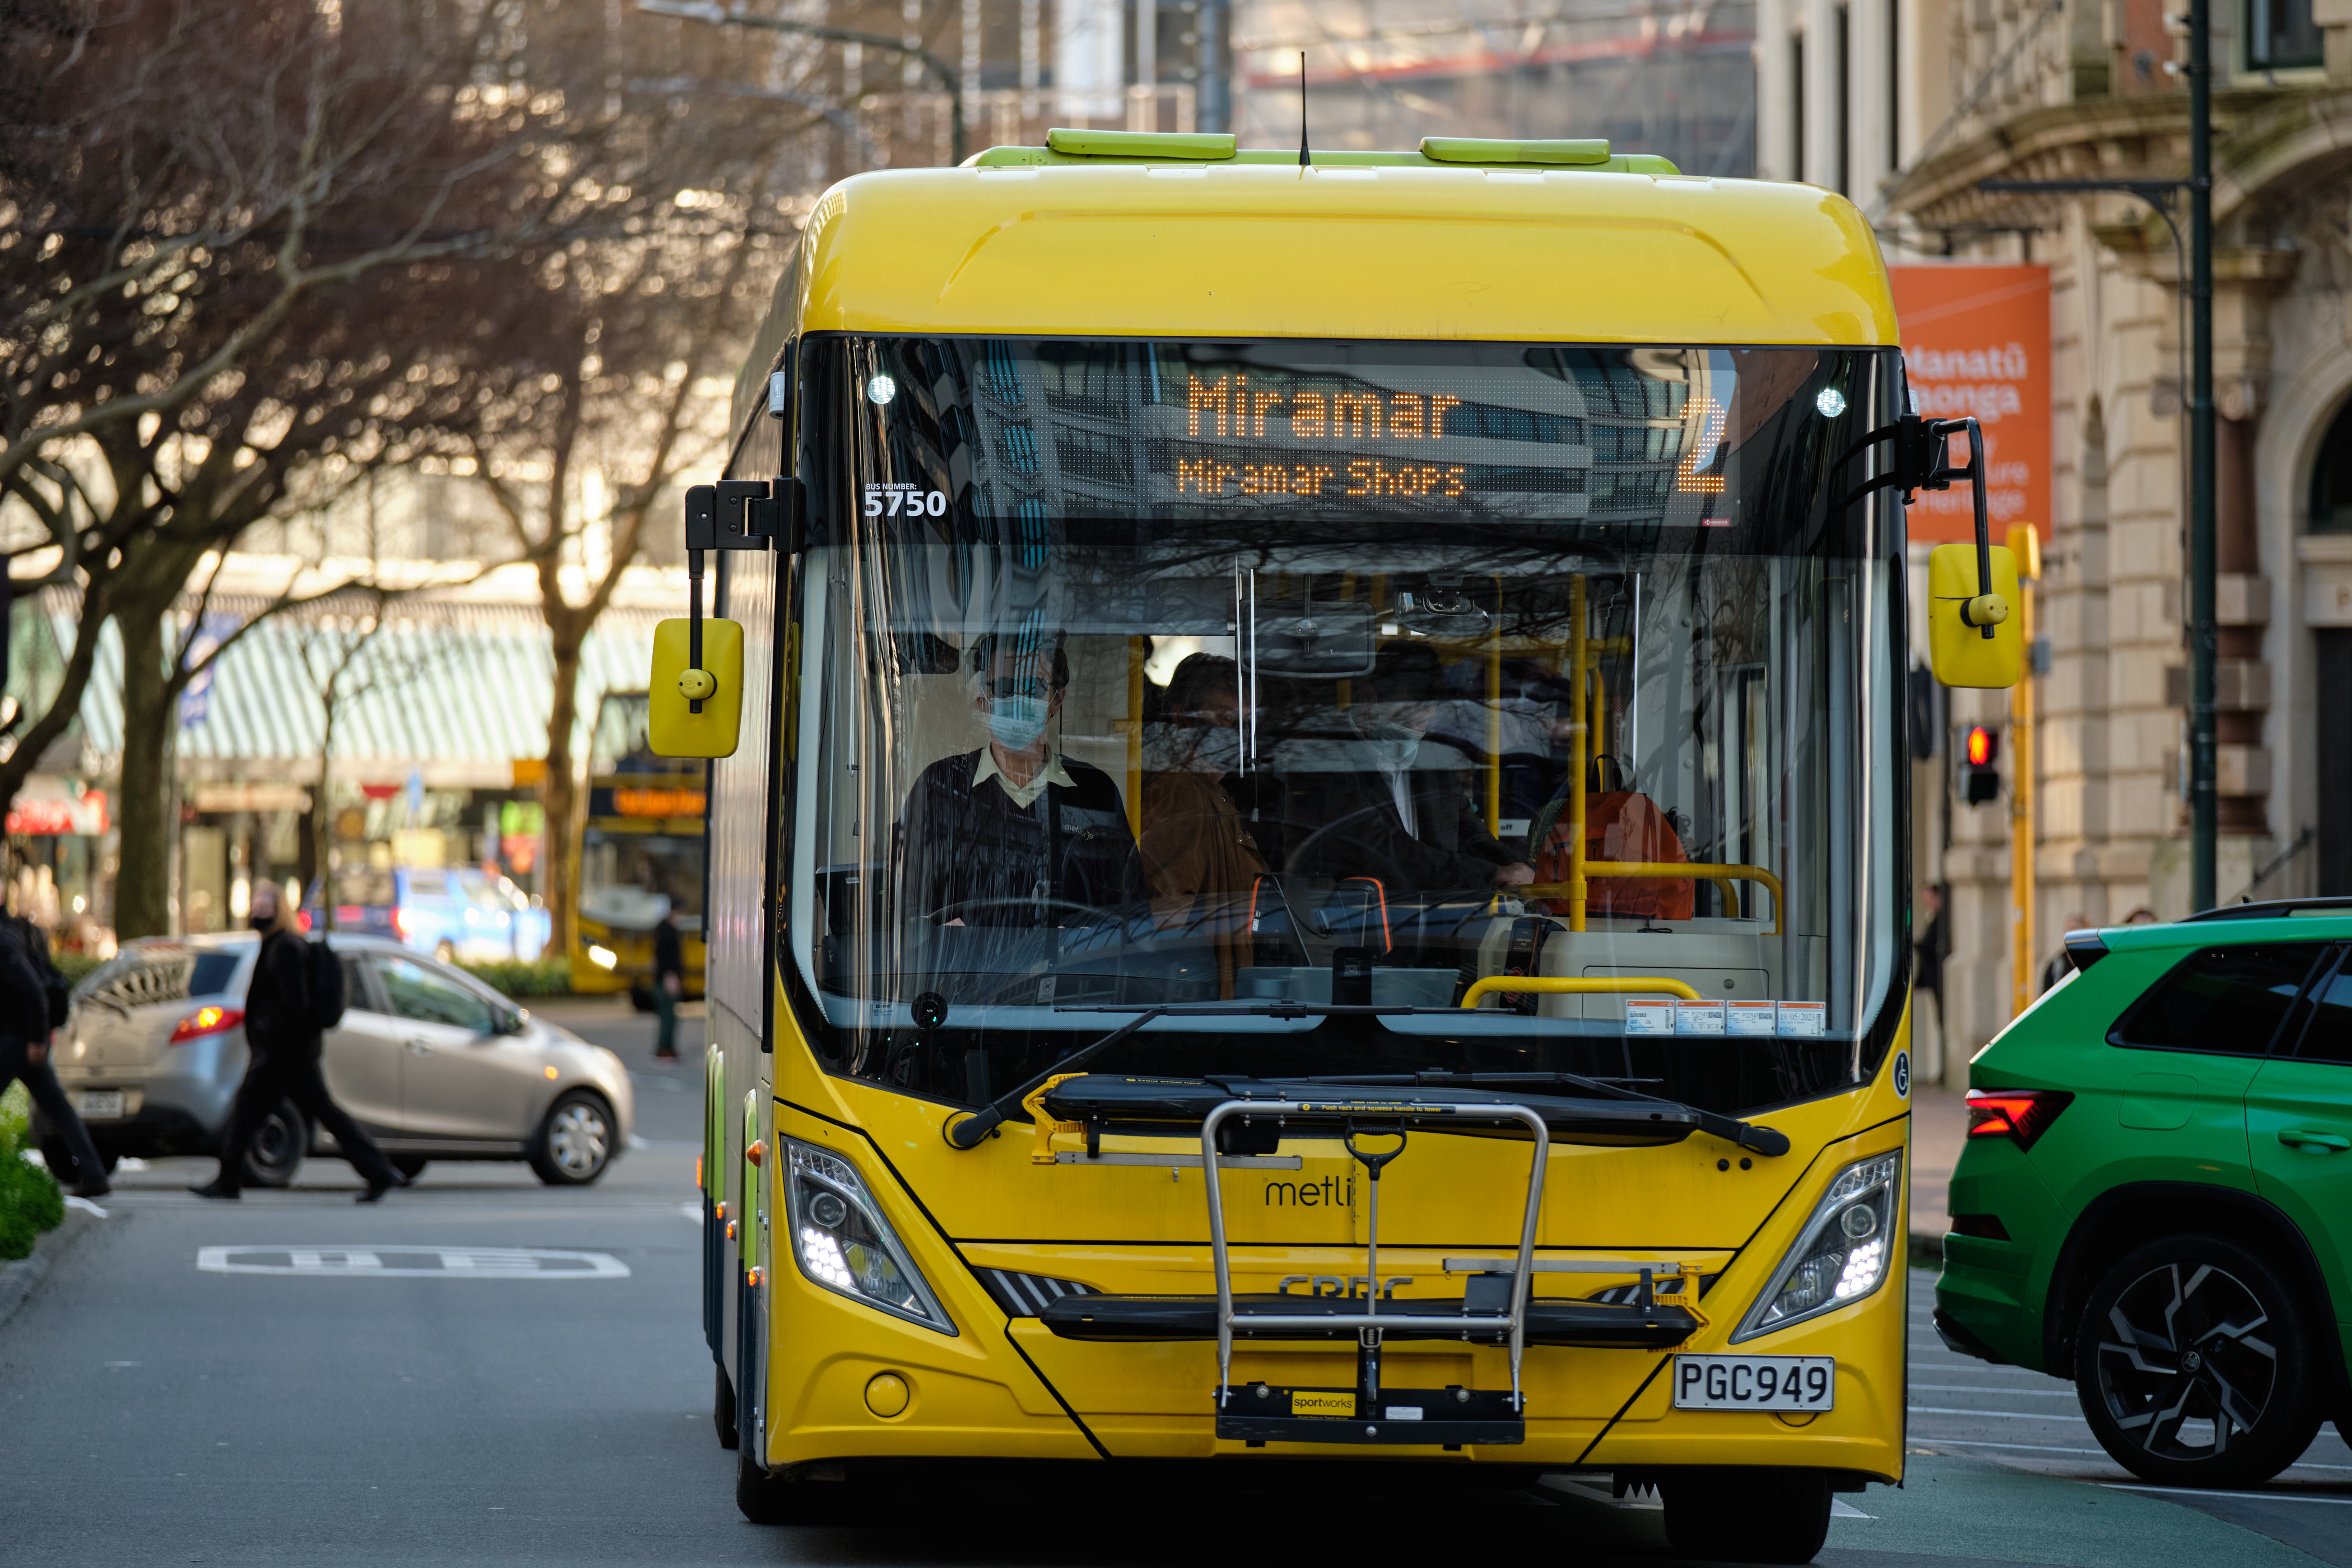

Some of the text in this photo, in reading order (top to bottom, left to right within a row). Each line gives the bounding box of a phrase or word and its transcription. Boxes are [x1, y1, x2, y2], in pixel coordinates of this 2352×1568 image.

[1188, 374, 1461, 439] Miramar
[1678, 398, 1725, 493] 2
[1178, 458, 1465, 497] Miramar Shops
[865, 491, 946, 516] 5750
[1780, 1013, 1815, 1021] 19/05/2023
[1680, 1363, 1827, 1403] PGC949
[1294, 1398, 1353, 1408] sportworks
